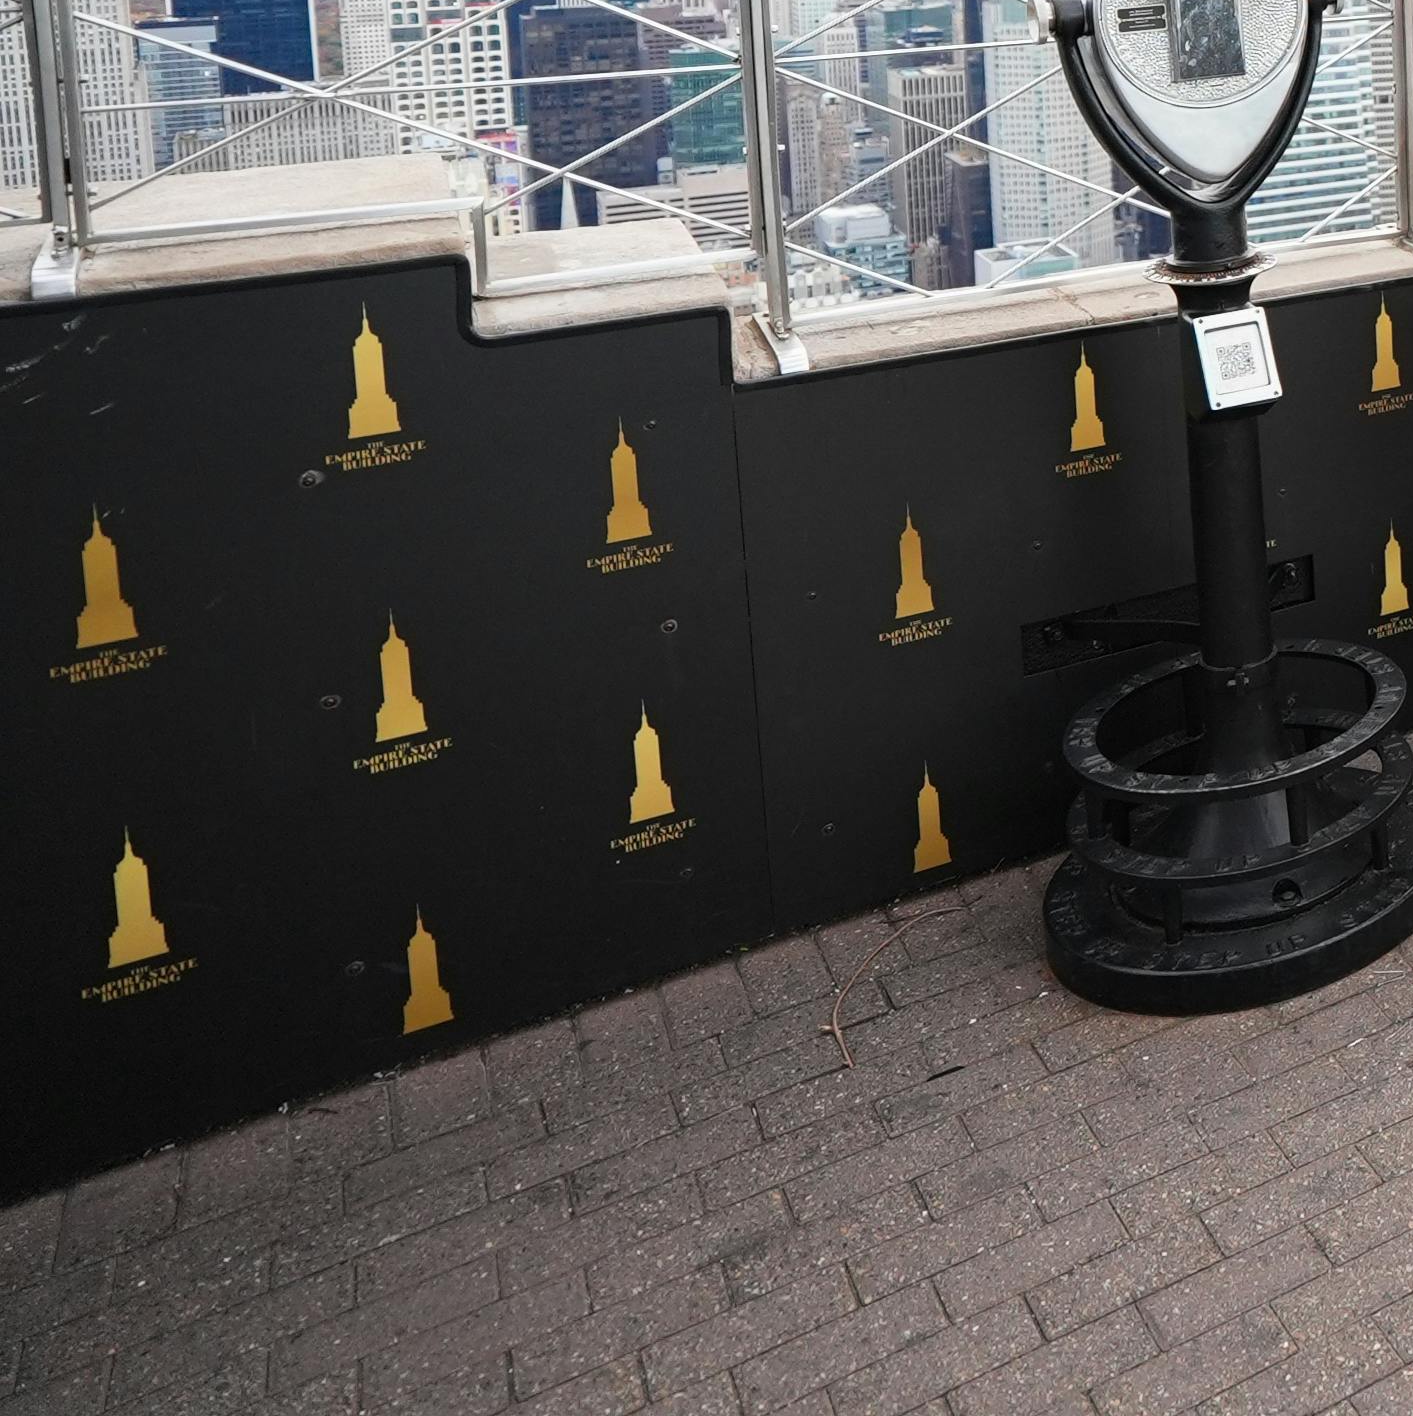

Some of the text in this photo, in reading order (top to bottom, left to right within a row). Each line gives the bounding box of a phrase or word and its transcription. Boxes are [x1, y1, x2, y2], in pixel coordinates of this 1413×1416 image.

[326, 440, 426, 464] EMPIRE STATE
[343, 451, 411, 471] BUILDING
[587, 543, 673, 568] EMPIRE STATE
[602, 554, 661, 573] BUILDING
[879, 617, 952, 641] EMPIRE STATE
[892, 627, 942, 646] BUILDING
[51, 645, 167, 678] EMPIRE STATE
[71, 658, 150, 683] BUILDING
[354, 737, 452, 769] EMPIRE STATE
[371, 750, 438, 774] BUILDING
[611, 818, 696, 849] EMPIRE STATE
[625, 829, 683, 853] BUILDING
[83, 957, 198, 999] EMPIRE STATE
[102, 972, 181, 1002] BUILDING
